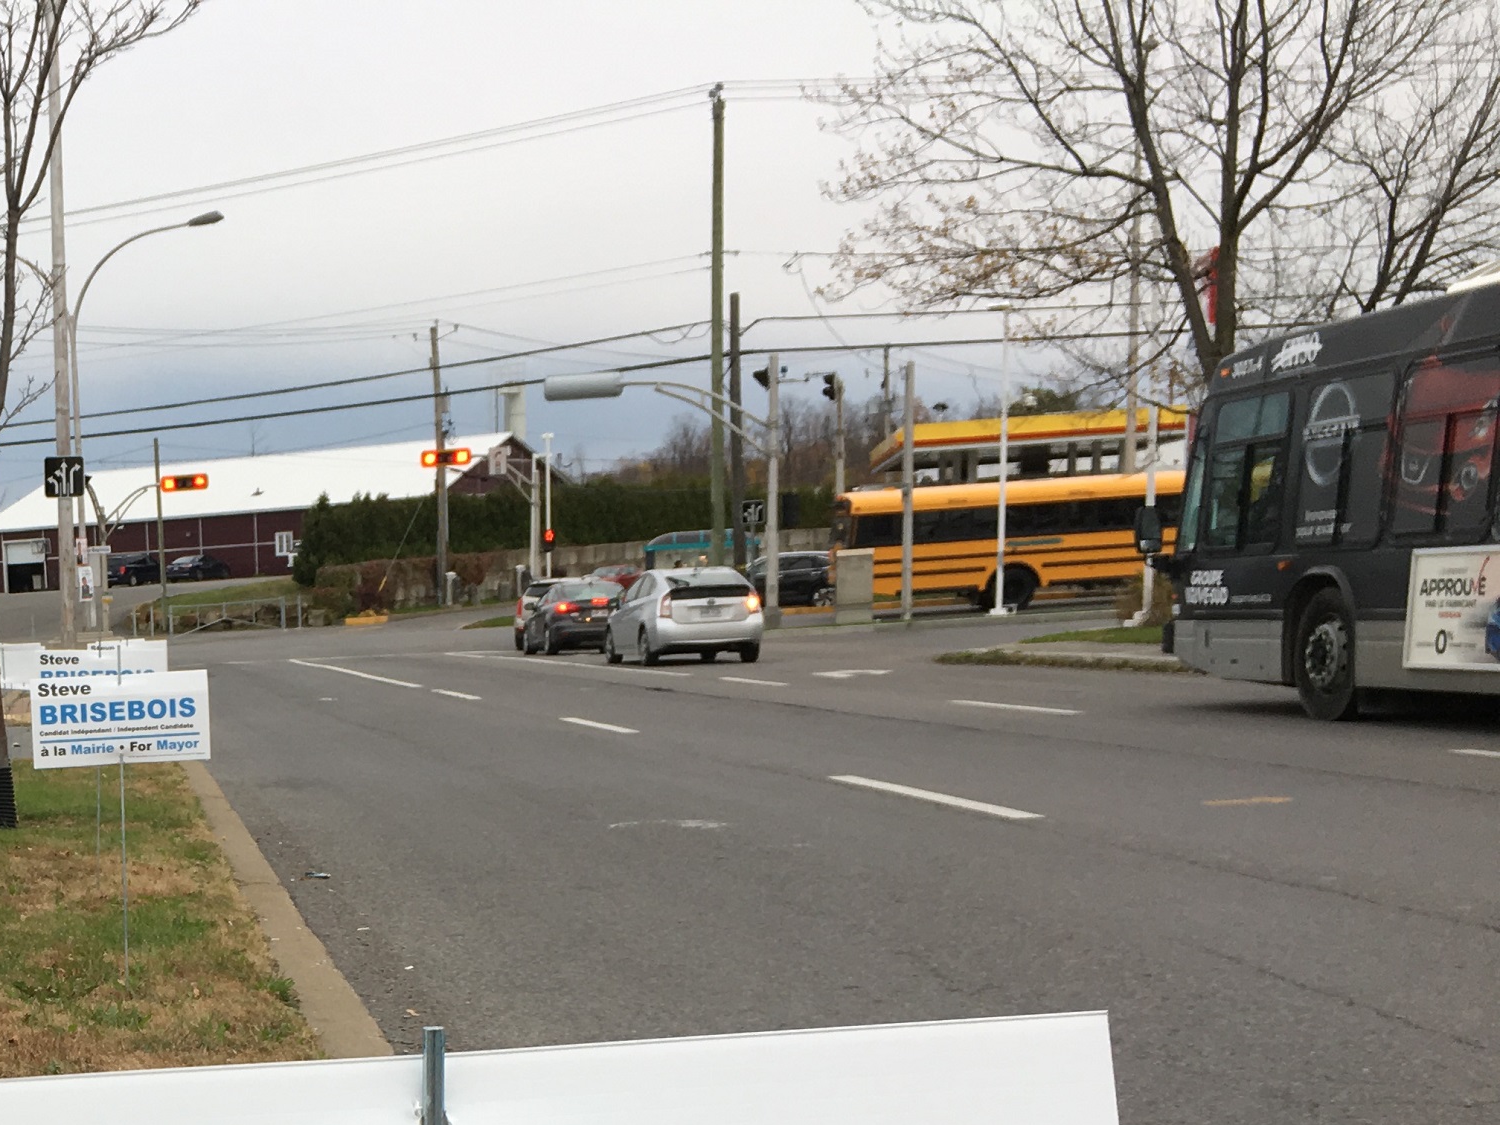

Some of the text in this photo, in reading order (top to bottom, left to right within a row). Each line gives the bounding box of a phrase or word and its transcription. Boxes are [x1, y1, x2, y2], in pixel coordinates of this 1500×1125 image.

[40, 654, 80, 666] Steve
[38, 683, 92, 698] Steve
[39, 697, 197, 726] BRISEBOIS
[117, 724, 159, 733] Independent
[41, 746, 50, 757] à
[53, 745, 67, 757] la
[71, 743, 115, 756] Mairie
[129, 741, 153, 752] For
[156, 739, 200, 752] Mayor
